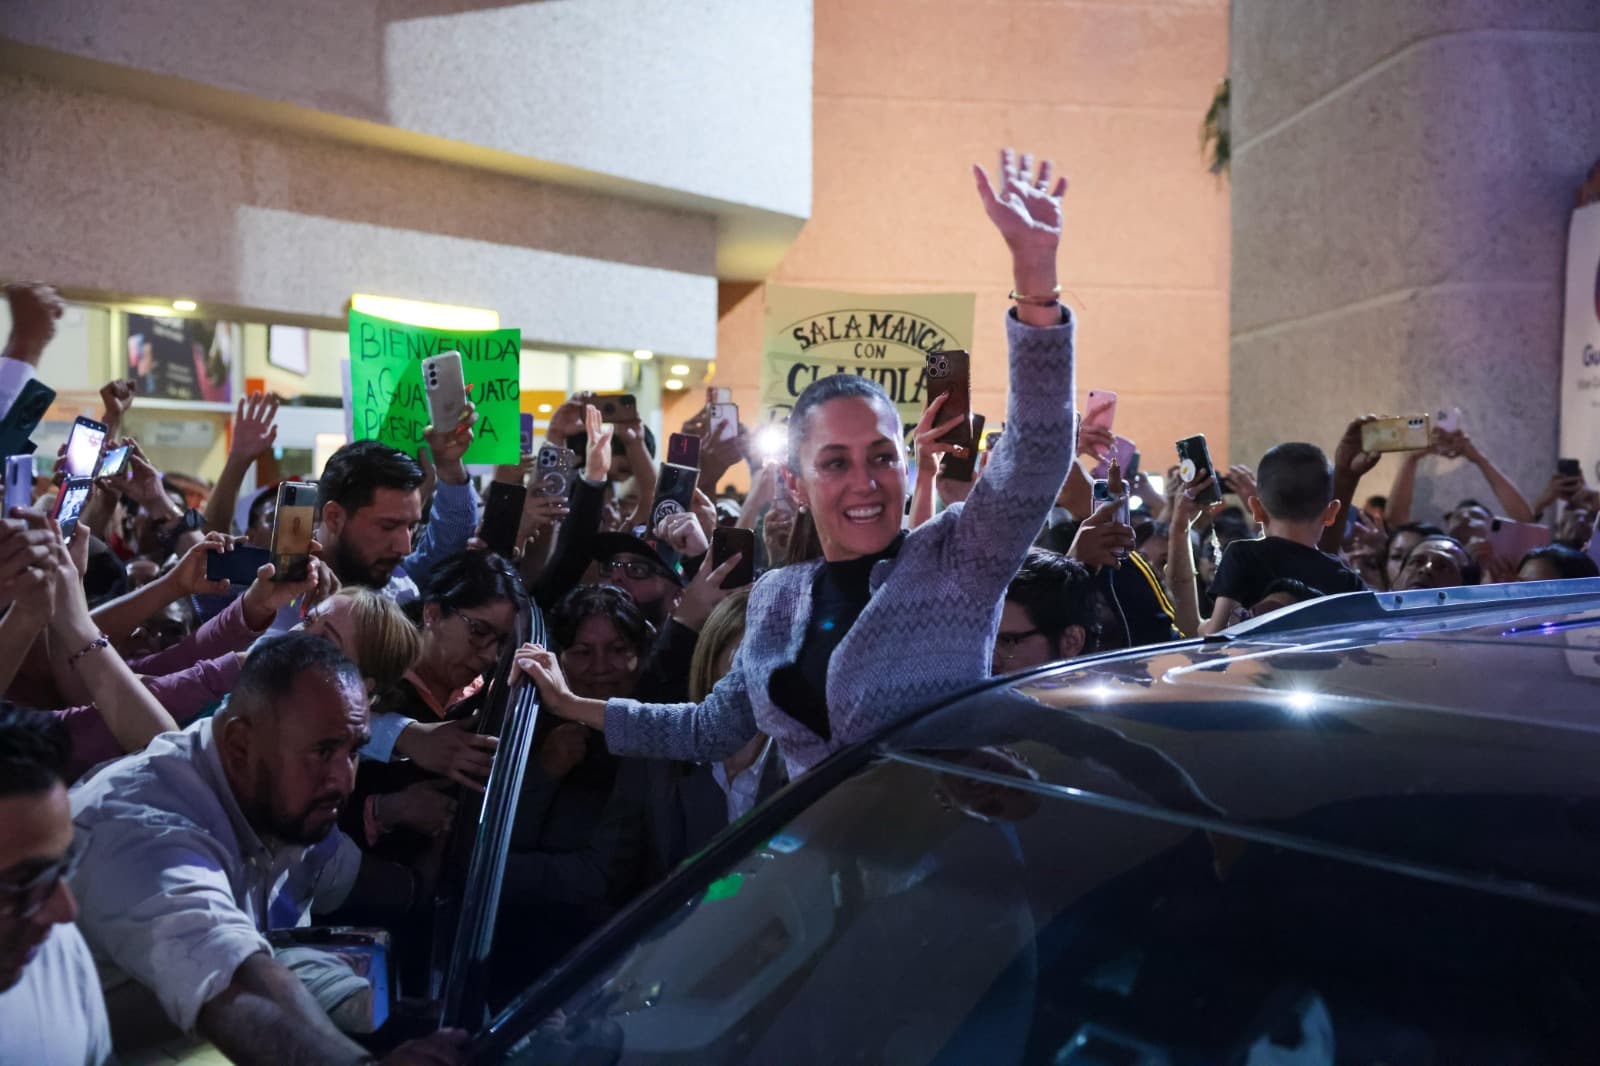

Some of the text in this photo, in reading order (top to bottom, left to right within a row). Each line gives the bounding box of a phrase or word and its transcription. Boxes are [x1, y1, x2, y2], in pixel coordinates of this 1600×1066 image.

[360, 322, 519, 364] BIENVENIDA
[793, 313, 947, 352] SALAMANCA
[854, 342, 887, 359] CON
[378, 367, 520, 412] GUAUATO
[364, 408, 499, 444] PRESIDA
